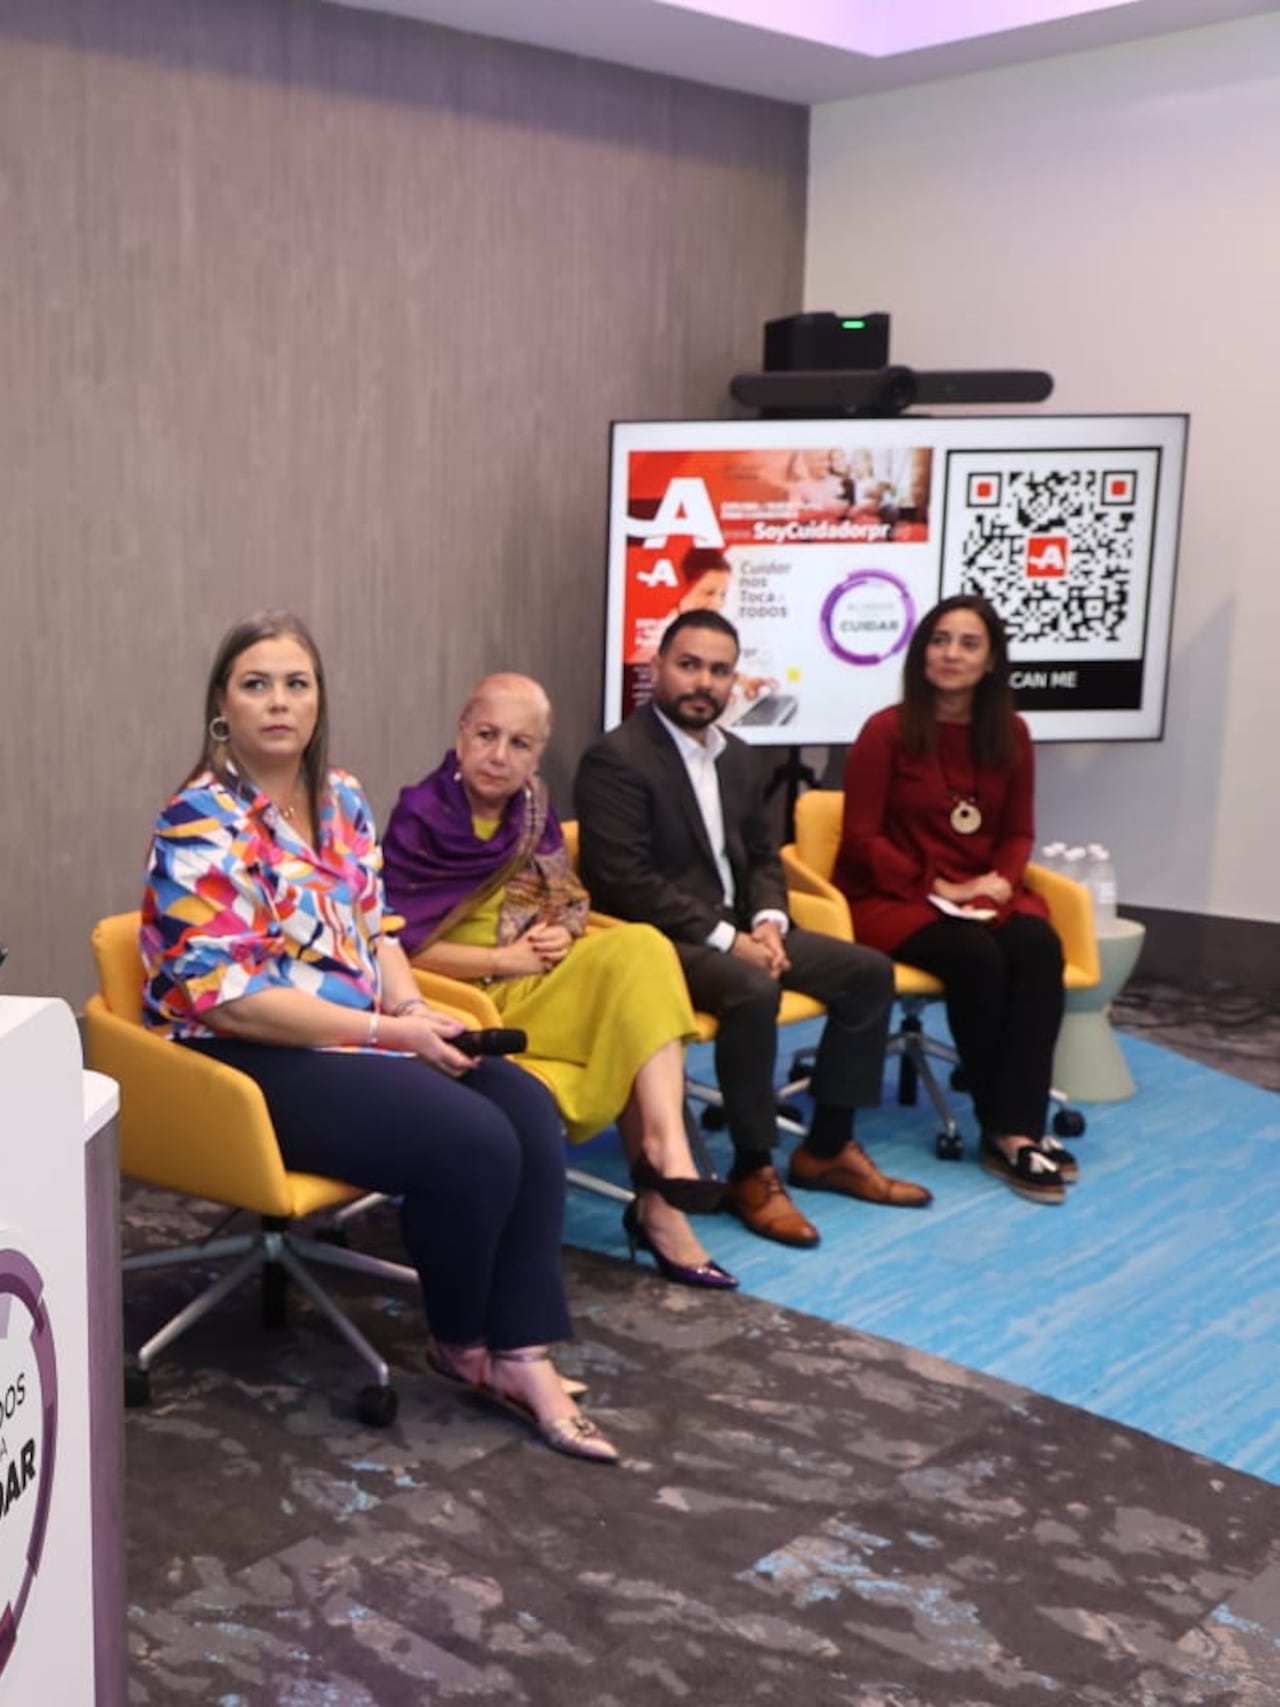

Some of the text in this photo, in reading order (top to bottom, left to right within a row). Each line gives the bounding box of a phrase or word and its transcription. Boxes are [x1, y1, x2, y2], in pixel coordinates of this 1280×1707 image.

[753, 521, 891, 542] SoyCuidadorpr
[739, 605, 788, 618] TODOS
[840, 619, 899, 632] CUIDAR
[1008, 671, 1078, 689] CAN ME
